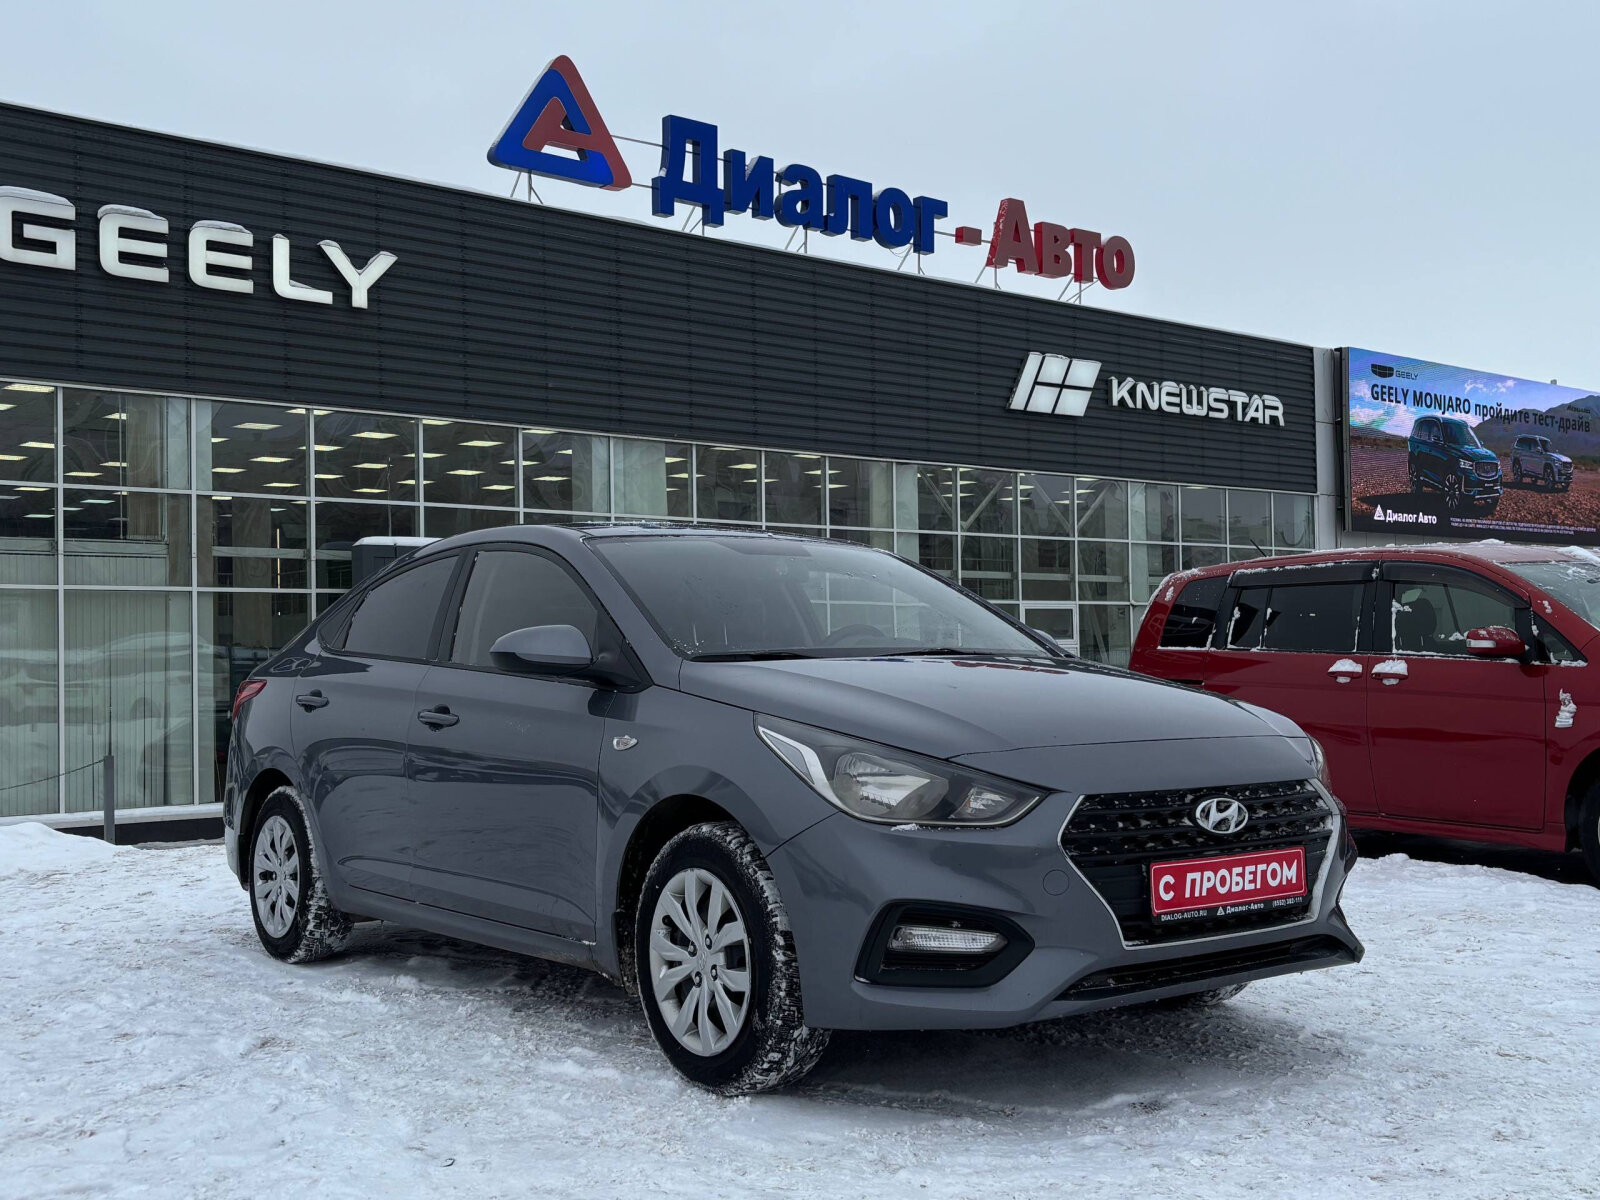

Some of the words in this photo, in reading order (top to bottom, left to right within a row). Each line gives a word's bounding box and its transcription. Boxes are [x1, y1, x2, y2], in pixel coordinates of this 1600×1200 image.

[0, 190, 398, 309] GEELY
[1395, 369, 1419, 381] GEELY
[1110, 377, 1285, 427] KNEWSTAR
[1370, 383, 1409, 404] GEELY
[1413, 390, 1471, 415] MONJARO
[1474, 402, 1530, 426] пройдите
[1532, 412, 1591, 434] тест-драйв
[1386, 509, 1417, 523] Диалог
[1418, 512, 1437, 524] Авто
[1159, 874, 1175, 901] С
[1185, 859, 1298, 898] ПРОБЕГОМ
[1161, 910, 1207, 922] DIALOG-AUTO.RU
[1225, 902, 1264, 914] Диалог-Авто
